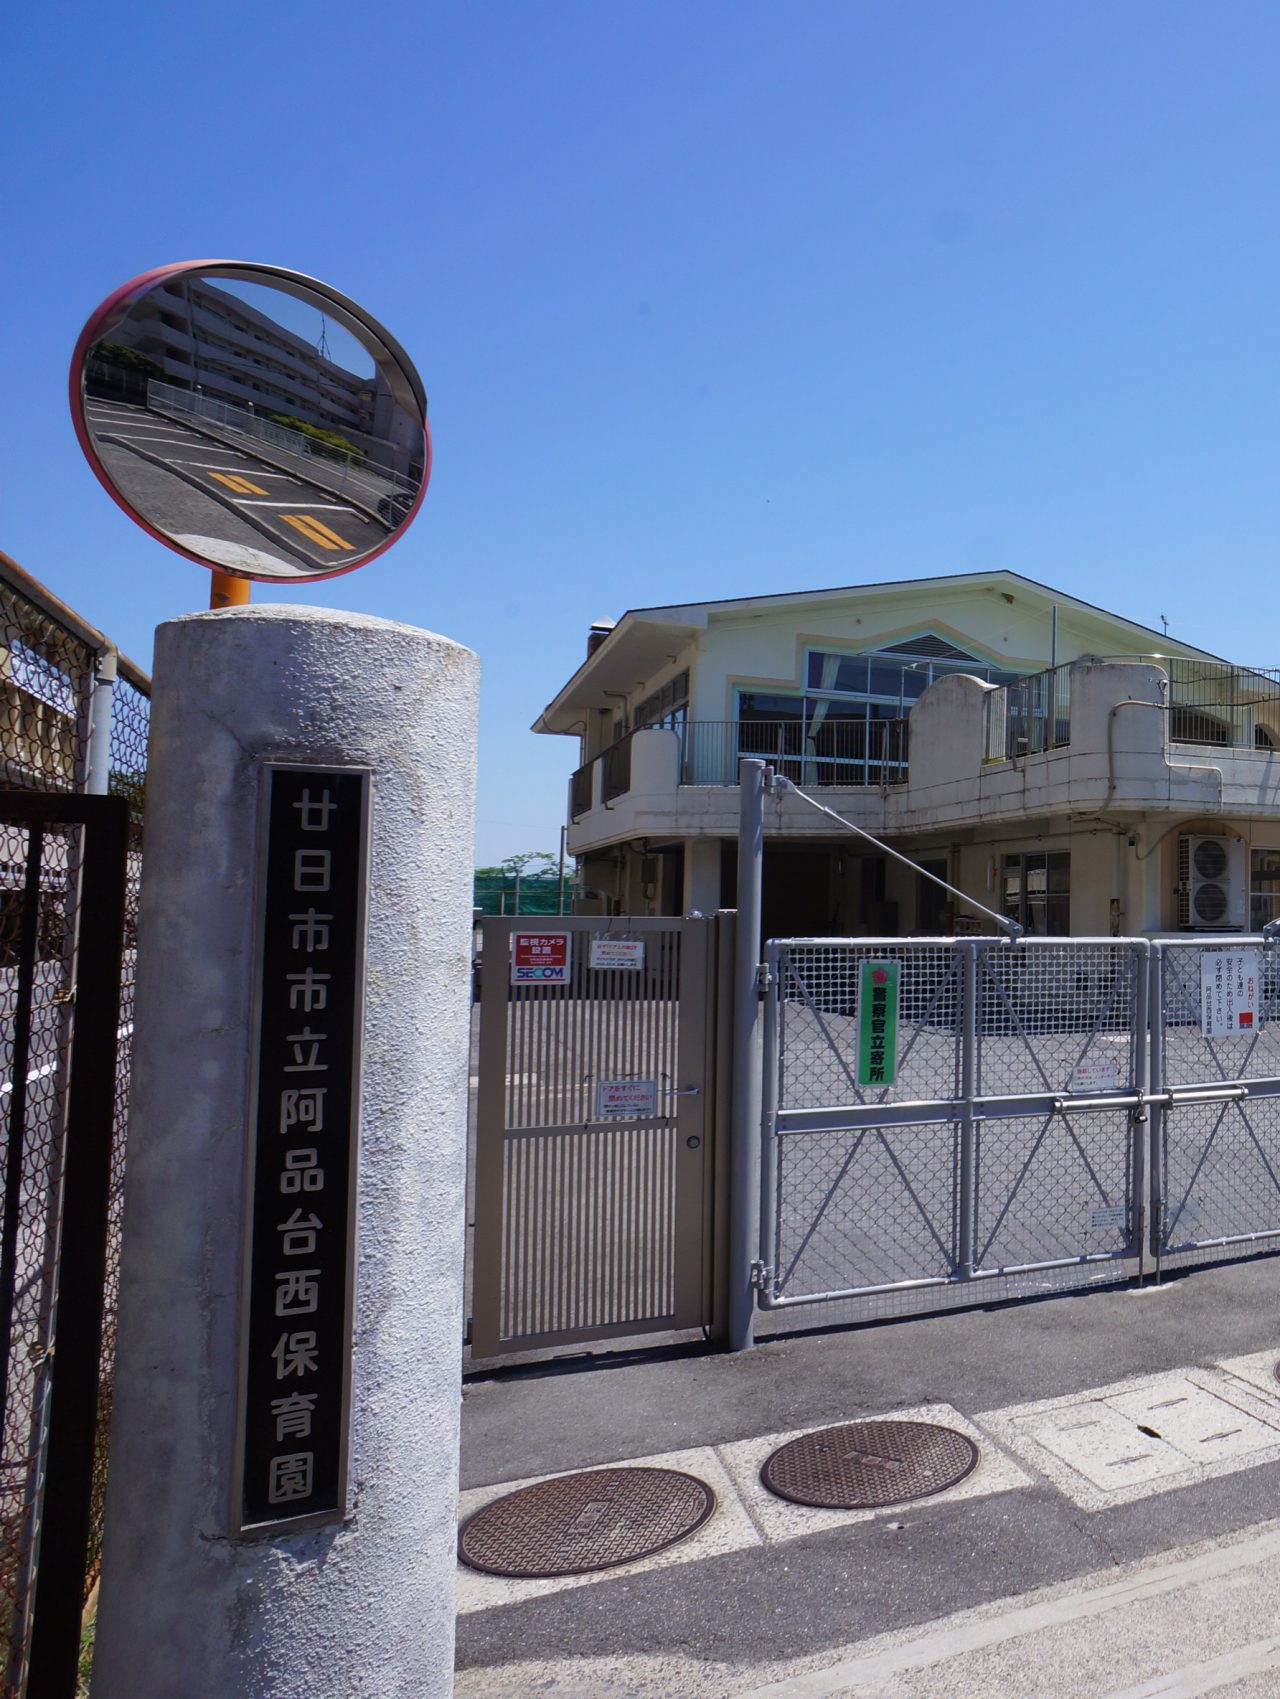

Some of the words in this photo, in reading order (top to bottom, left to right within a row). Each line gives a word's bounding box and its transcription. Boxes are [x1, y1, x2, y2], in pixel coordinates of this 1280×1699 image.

[519, 938, 564, 946] 監視カメラ
[531, 946, 552, 954] 設置
[517, 967, 564, 978] SECOM
[869, 986, 887, 1081] 警察官立寄所
[267, 786, 339, 1505] 廿日市市立阿品台西保育園
